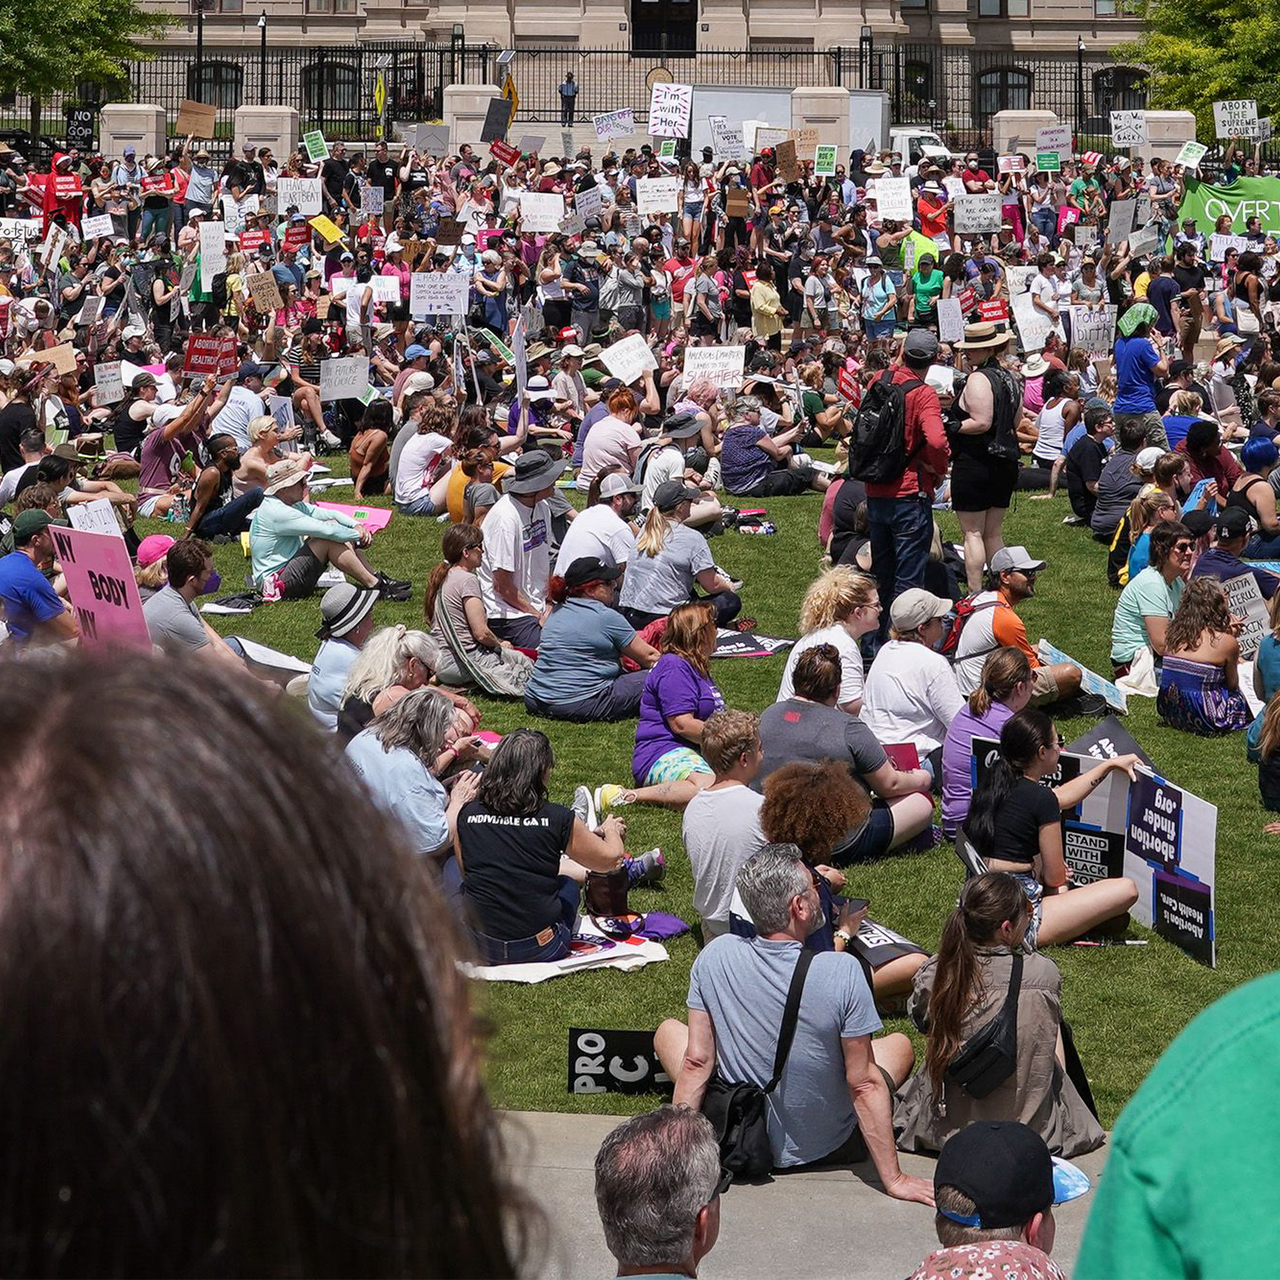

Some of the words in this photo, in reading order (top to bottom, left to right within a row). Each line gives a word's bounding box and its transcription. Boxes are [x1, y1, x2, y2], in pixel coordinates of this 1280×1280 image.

[663, 91, 680, 101] I'm
[660, 106, 681, 114] with
[1221, 100, 1255, 111] ABORT
[73, 111, 91, 121] NO
[594, 113, 617, 126] BANS
[619, 109, 632, 118] OFF
[660, 118, 678, 127] Her
[1227, 111, 1247, 119] THE
[68, 126, 92, 136] GOP
[596, 123, 611, 134] OUR
[1222, 119, 1257, 128] SUPREME
[1227, 126, 1257, 136] COURT
[1117, 133, 1141, 142] BACK!
[286, 180, 307, 191] HAVE
[308, 181, 316, 191] A
[279, 191, 320, 203] HEARTBEAT
[879, 198, 909, 208] RIGHT
[1214, 235, 1245, 247] TRUST
[1077, 323, 1111, 341] birth
[685, 369, 740, 385] SLAUGHTER
[53, 531, 76, 563] MY
[87, 570, 130, 609] BODY
[77, 606, 99, 640] MY
[1155, 788, 1177, 813] .org
[523, 817, 539, 827] GA
[1143, 807, 1177, 836] finder
[1067, 833, 1107, 849] STAND
[1131, 823, 1176, 862] abortion
[1067, 847, 1099, 862] WITH
[1068, 860, 1107, 876] BLACK
[1160, 892, 1178, 911] Care.
[1163, 909, 1171, 924] is
[1178, 902, 1204, 923] Health
[1172, 915, 1204, 939] Abortion
[574, 1032, 609, 1095] PRO
